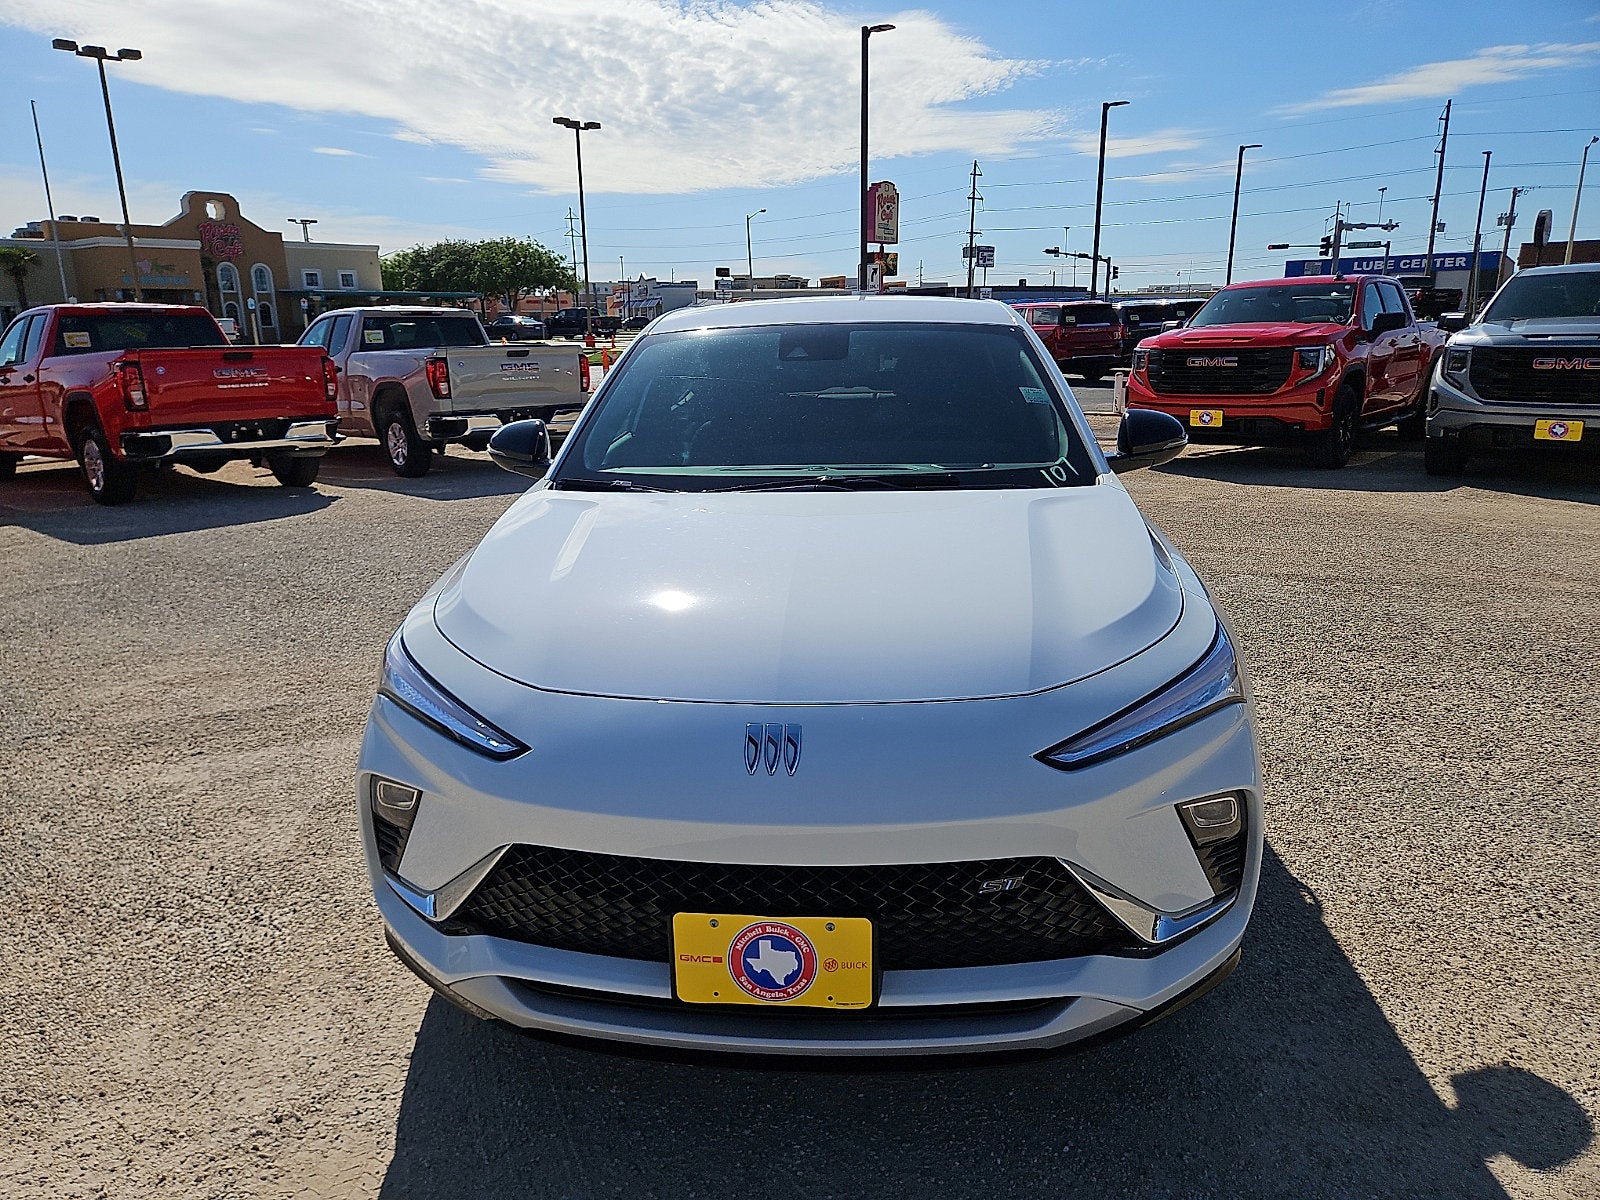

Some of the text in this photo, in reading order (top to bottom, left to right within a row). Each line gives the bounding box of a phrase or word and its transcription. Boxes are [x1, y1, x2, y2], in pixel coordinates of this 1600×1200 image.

[1353, 260, 1395, 271] LUBE
[1187, 357, 1239, 367] GMC
[1533, 357, 1600, 370] GMC
[979, 876, 1023, 894] ST
[735, 925, 810, 954] Mitchell Buick GMC
[679, 954, 712, 963] GMC
[841, 961, 868, 970] BUICK
[739, 975, 753, 990] San
[786, 978, 808, 995] Texas
